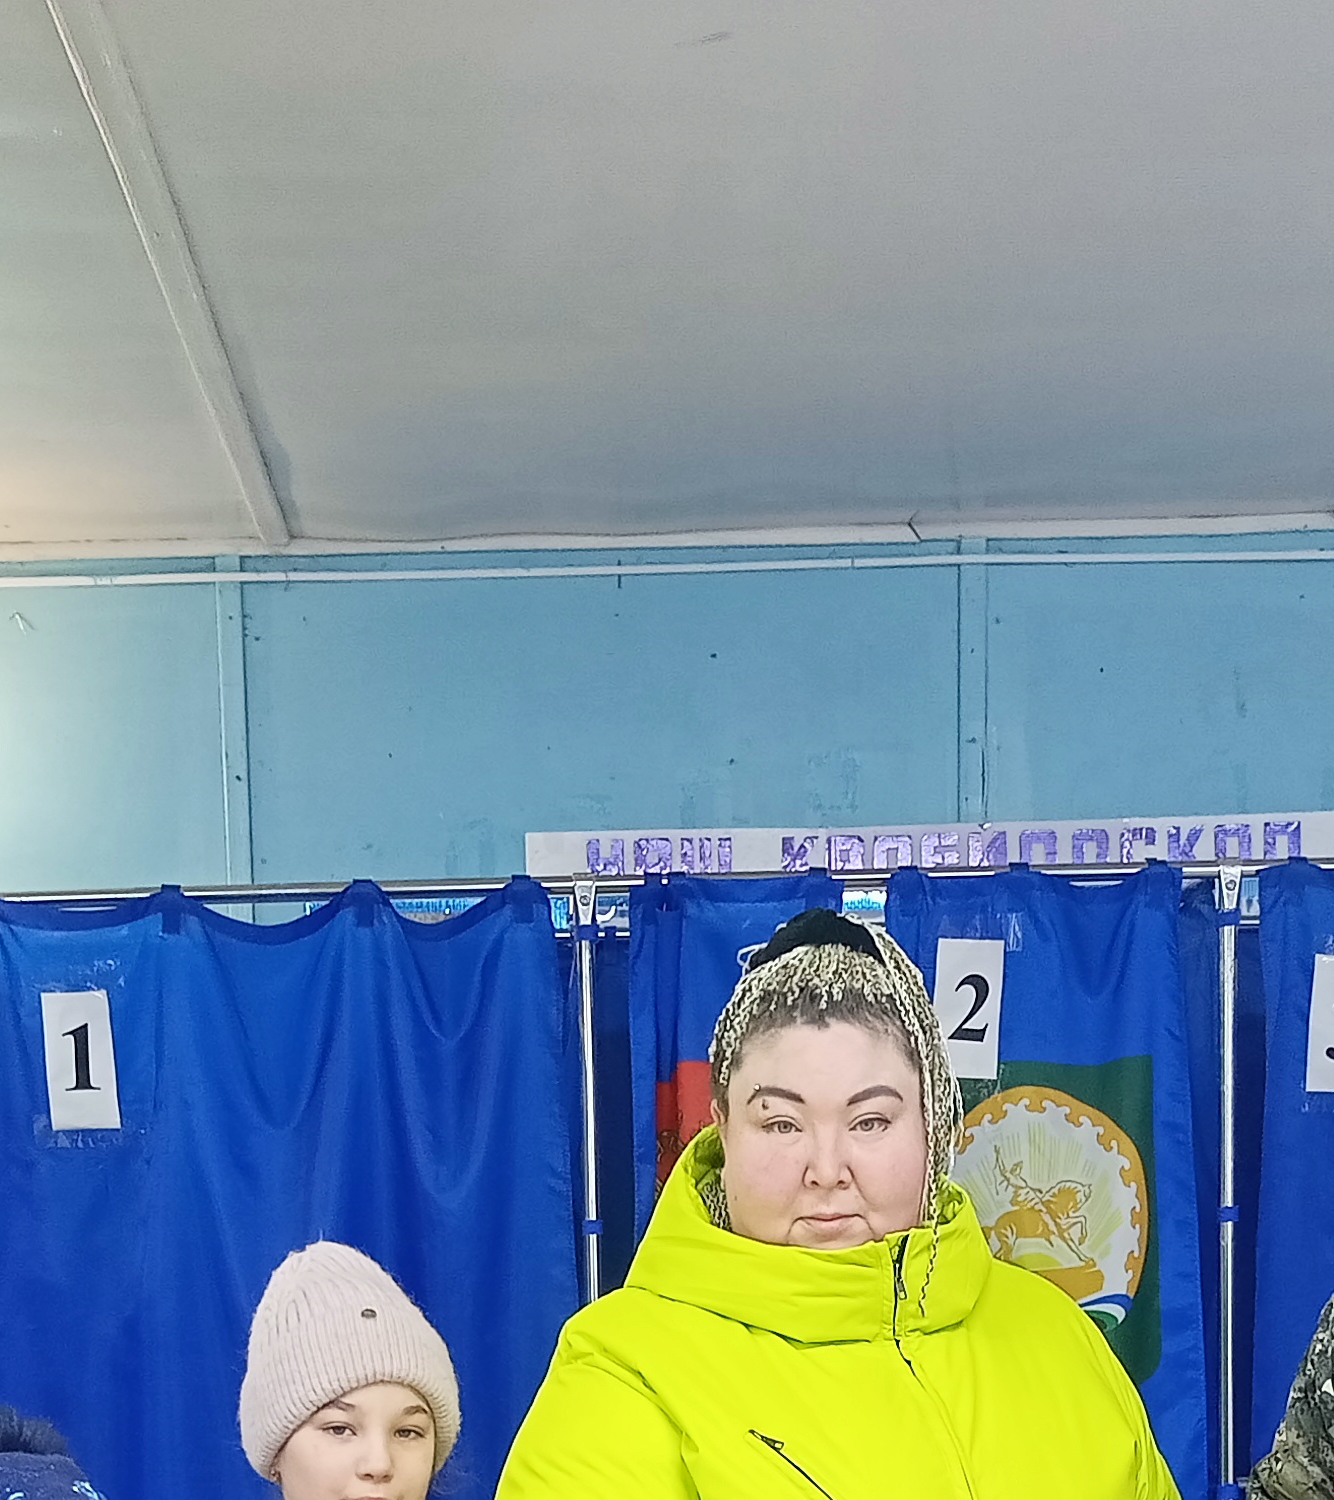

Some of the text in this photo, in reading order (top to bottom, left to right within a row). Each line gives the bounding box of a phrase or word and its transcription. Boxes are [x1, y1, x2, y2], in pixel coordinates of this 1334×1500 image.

[586, 835, 731, 876] НАШ
[948, 974, 990, 1042] 2
[61, 1022, 101, 1091] 1
